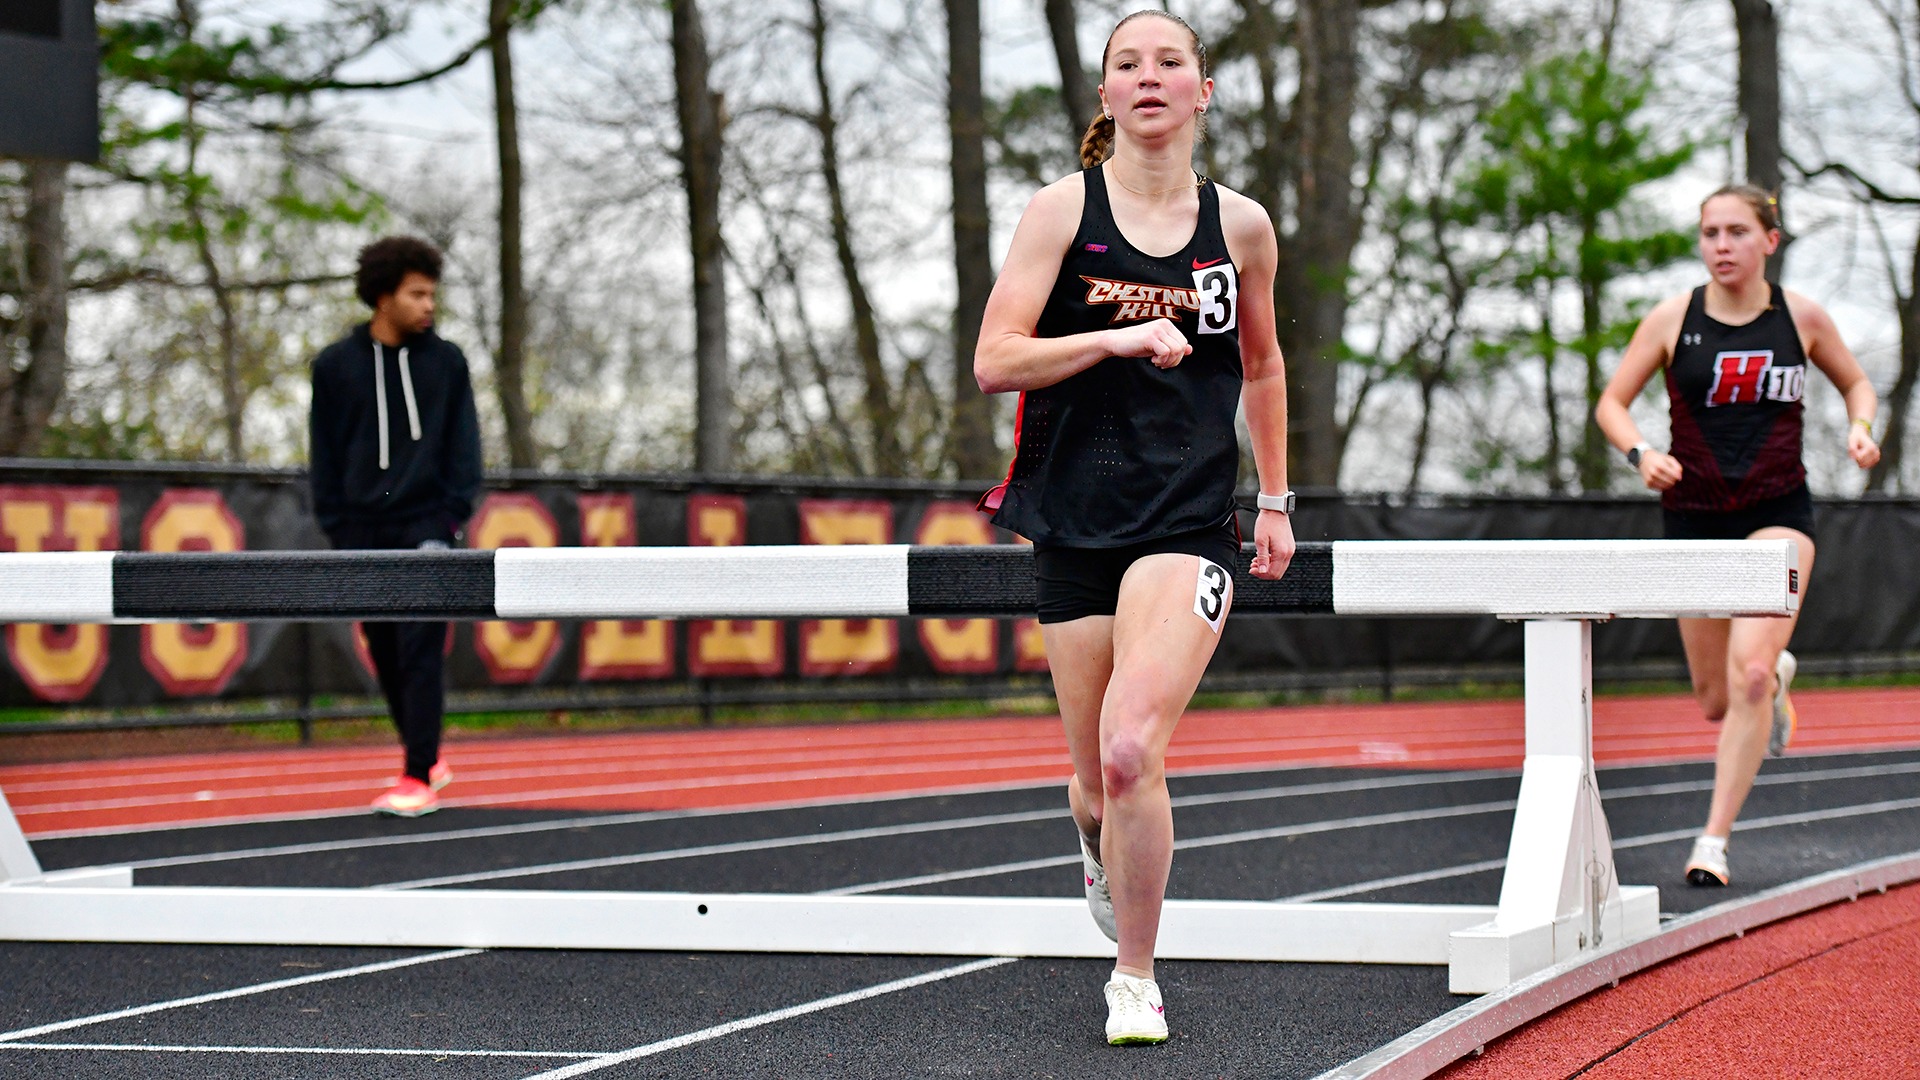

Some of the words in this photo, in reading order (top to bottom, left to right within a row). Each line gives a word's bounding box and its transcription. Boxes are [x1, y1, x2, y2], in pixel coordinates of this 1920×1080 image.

[1086, 278, 1200, 311] CHESTNU
[1203, 271, 1232, 330] 3
[1707, 350, 1773, 406] H
[1777, 369, 1802, 400] 10
[1201, 565, 1226, 621] 3
